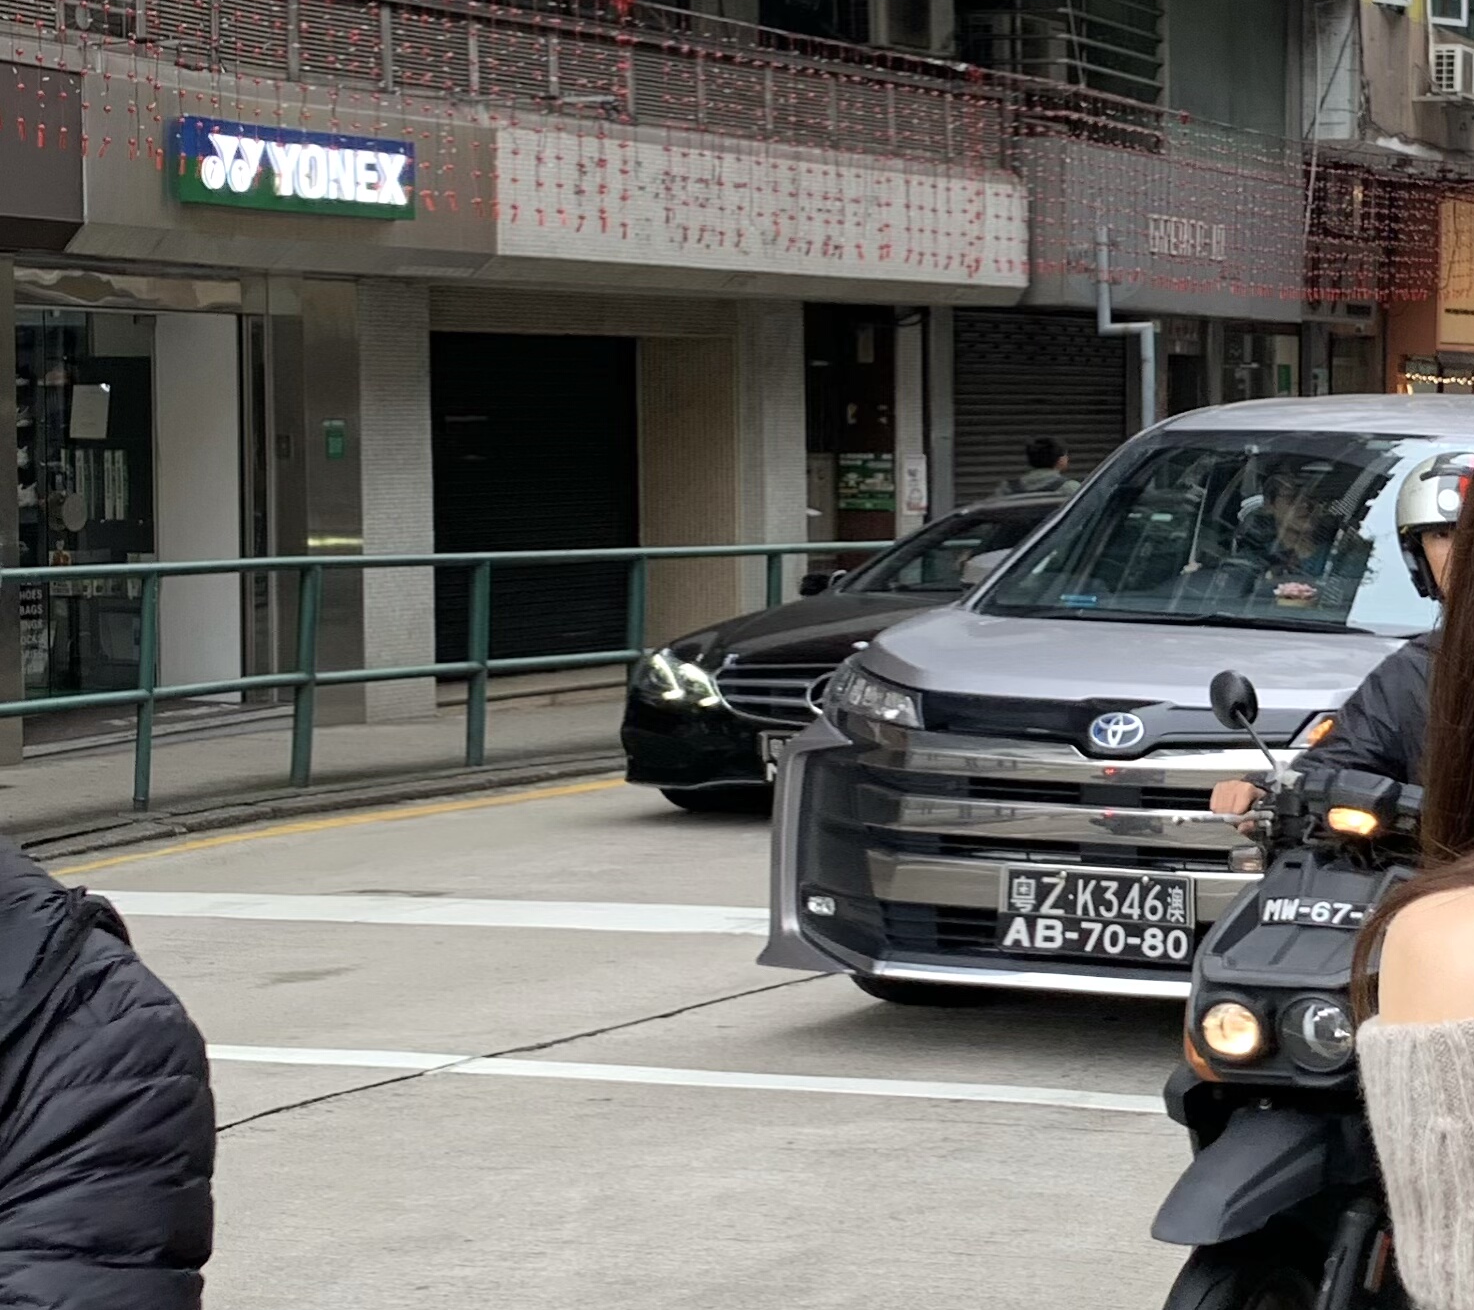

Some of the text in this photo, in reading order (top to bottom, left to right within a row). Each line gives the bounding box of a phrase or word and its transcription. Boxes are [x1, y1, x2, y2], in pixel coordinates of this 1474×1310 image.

[267, 141, 408, 206] YONEX
[1262, 897, 1374, 924] MW-67-
[1002, 916, 1189, 960] AB-70-80
